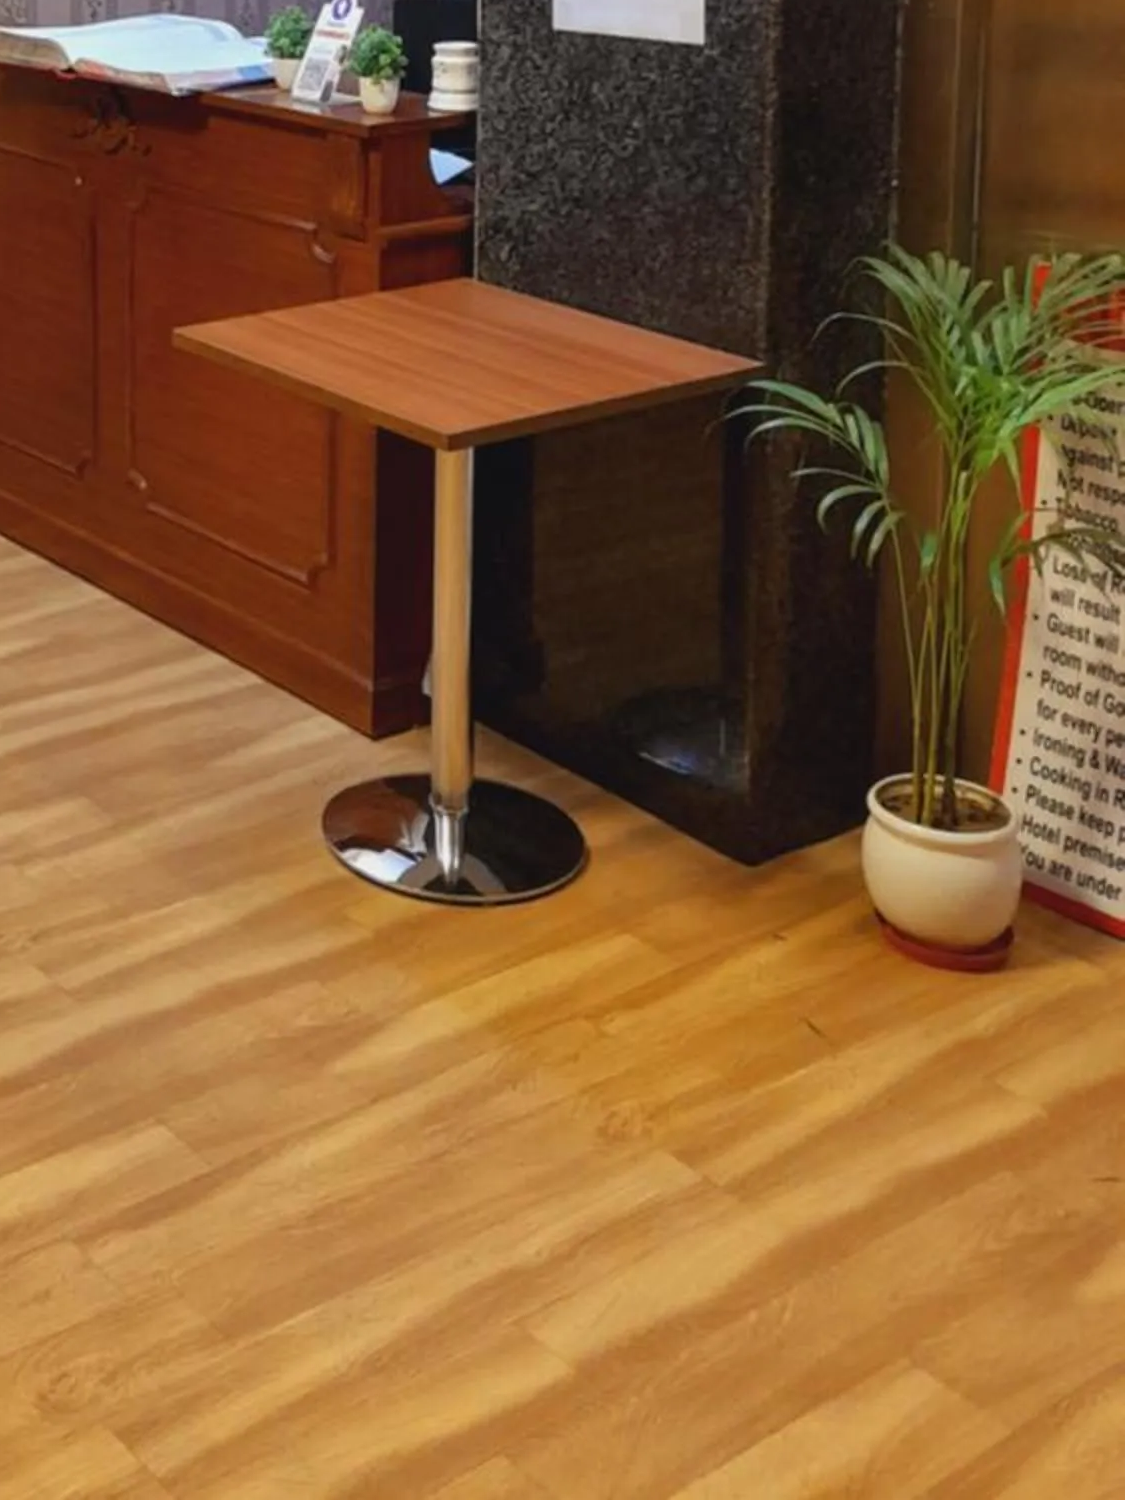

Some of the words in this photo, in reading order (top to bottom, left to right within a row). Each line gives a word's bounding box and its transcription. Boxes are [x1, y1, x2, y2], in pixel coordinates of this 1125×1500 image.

[1049, 587, 1076, 609] will
[1078, 597, 1121, 627] result
[1047, 612, 1090, 645] Guest
[1093, 631, 1119, 656] will
[1043, 644, 1082, 672] room
[1040, 669, 1082, 700] Proof
[1083, 687, 1100, 709] of
[1036, 698, 1058, 721] for
[1061, 711, 1102, 744] every
[1032, 728, 1085, 770] Ironing
[1088, 748, 1100, 771] &
[1030, 755, 1092, 803] Cooking
[1094, 780, 1109, 805] in
[1021, 813, 1062, 846] Hotel
[1025, 783, 1075, 821] Please
[1078, 804, 1115, 840] keep
[1048, 859, 1073, 882] are
[1076, 870, 1123, 901] under
